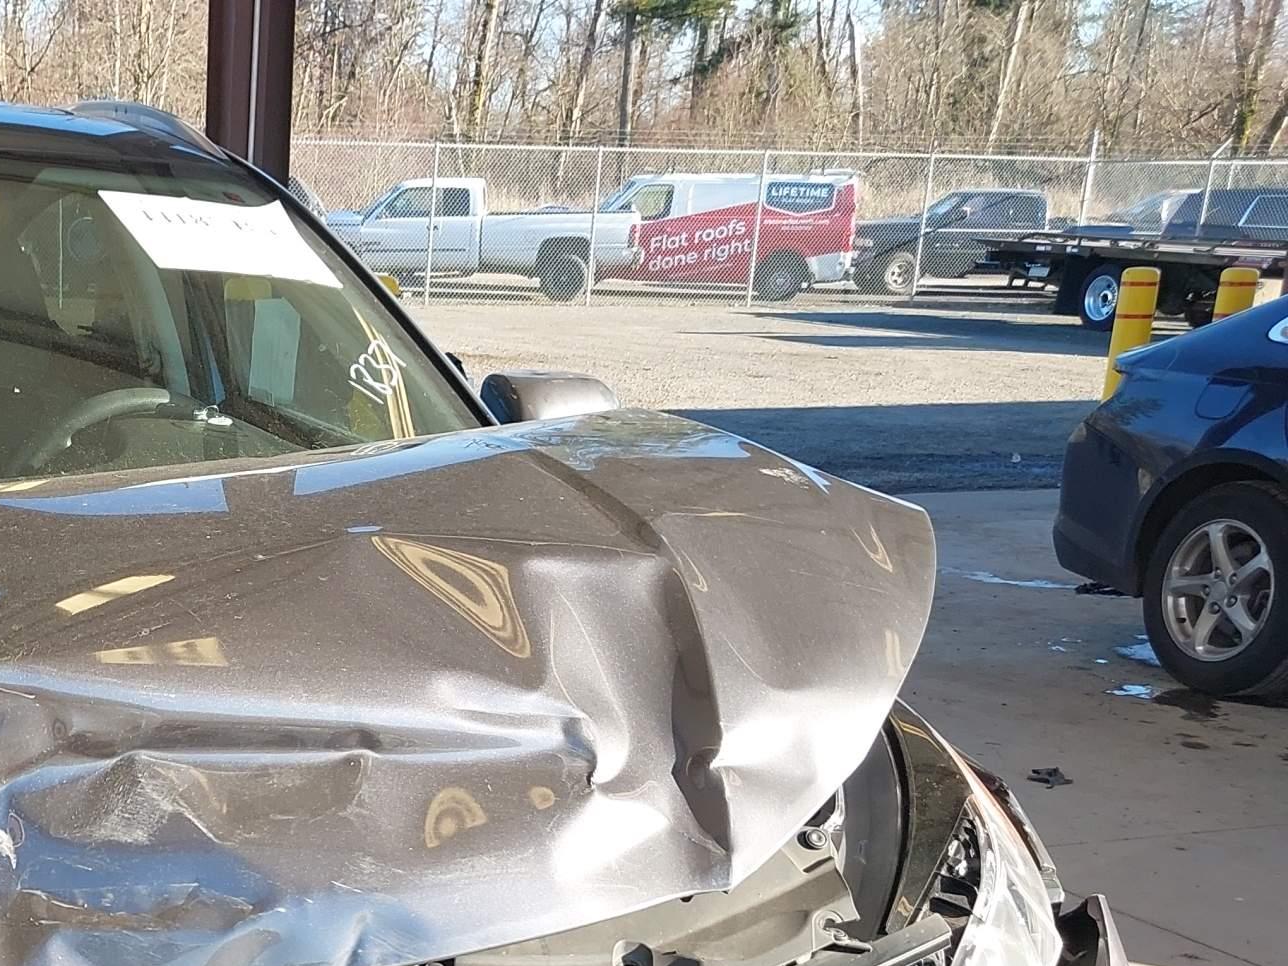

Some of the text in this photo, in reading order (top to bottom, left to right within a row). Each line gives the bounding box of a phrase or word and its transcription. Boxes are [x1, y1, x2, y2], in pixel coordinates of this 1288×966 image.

[771, 187, 829, 197] LIFETIME
[649, 219, 746, 252] Flat roofs
[648, 252, 697, 271] done
[704, 239, 753, 261] right
